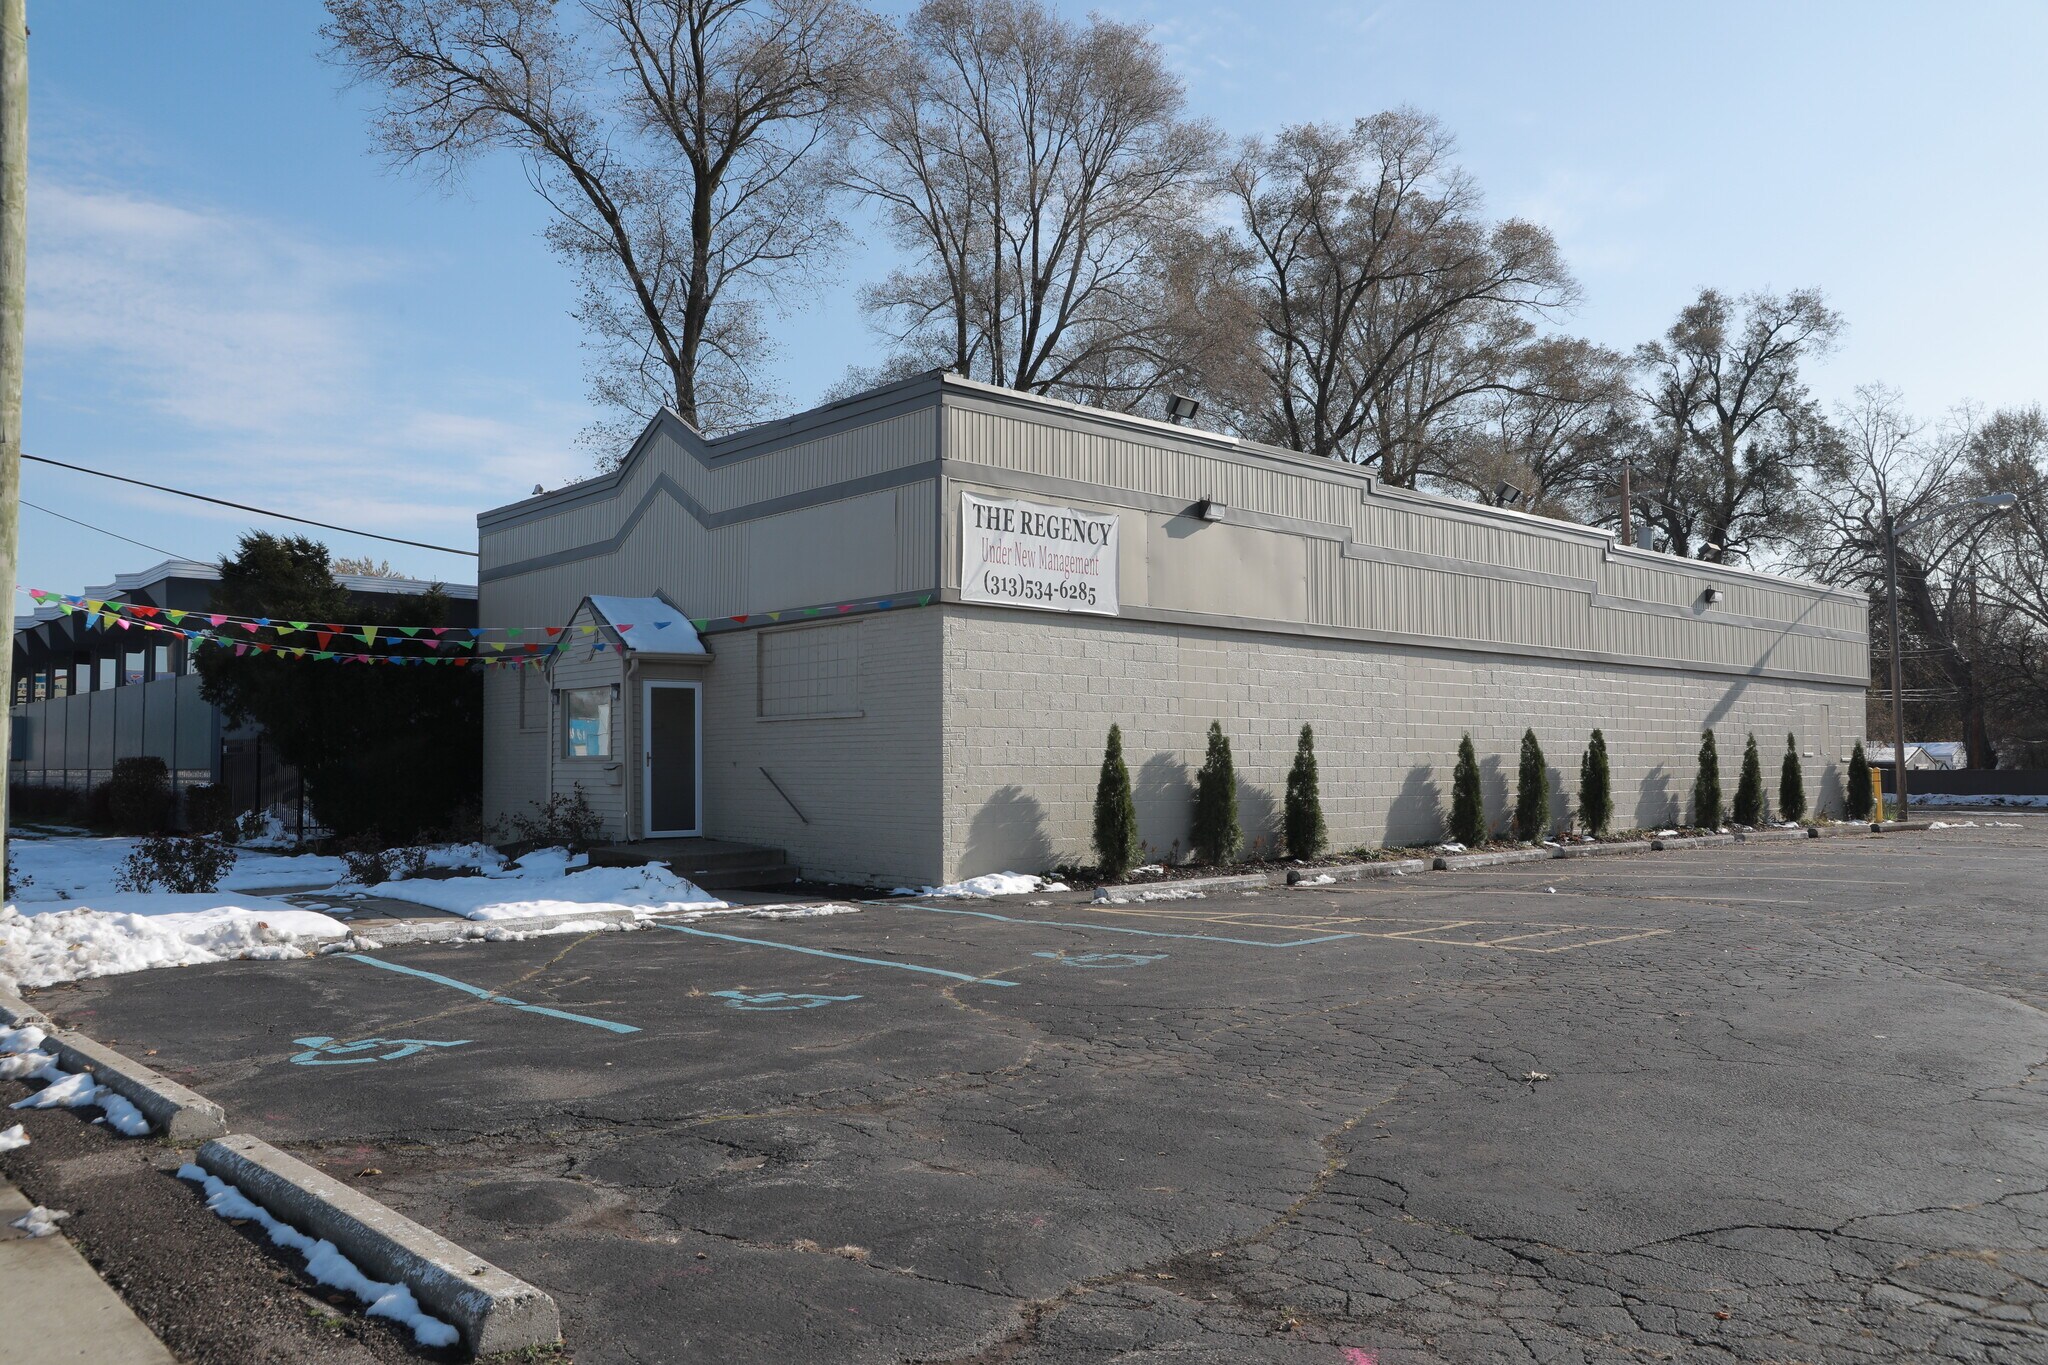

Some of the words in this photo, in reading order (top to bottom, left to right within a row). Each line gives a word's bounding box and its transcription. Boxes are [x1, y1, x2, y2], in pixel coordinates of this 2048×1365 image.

[972, 503, 1015, 533] THE
[1020, 510, 1112, 546] REGENCY
[981, 537, 1012, 566] Under
[1014, 541, 1036, 569] New
[1038, 545, 1099, 579] Management
[984, 569, 1096, 606] (313)534-6285
